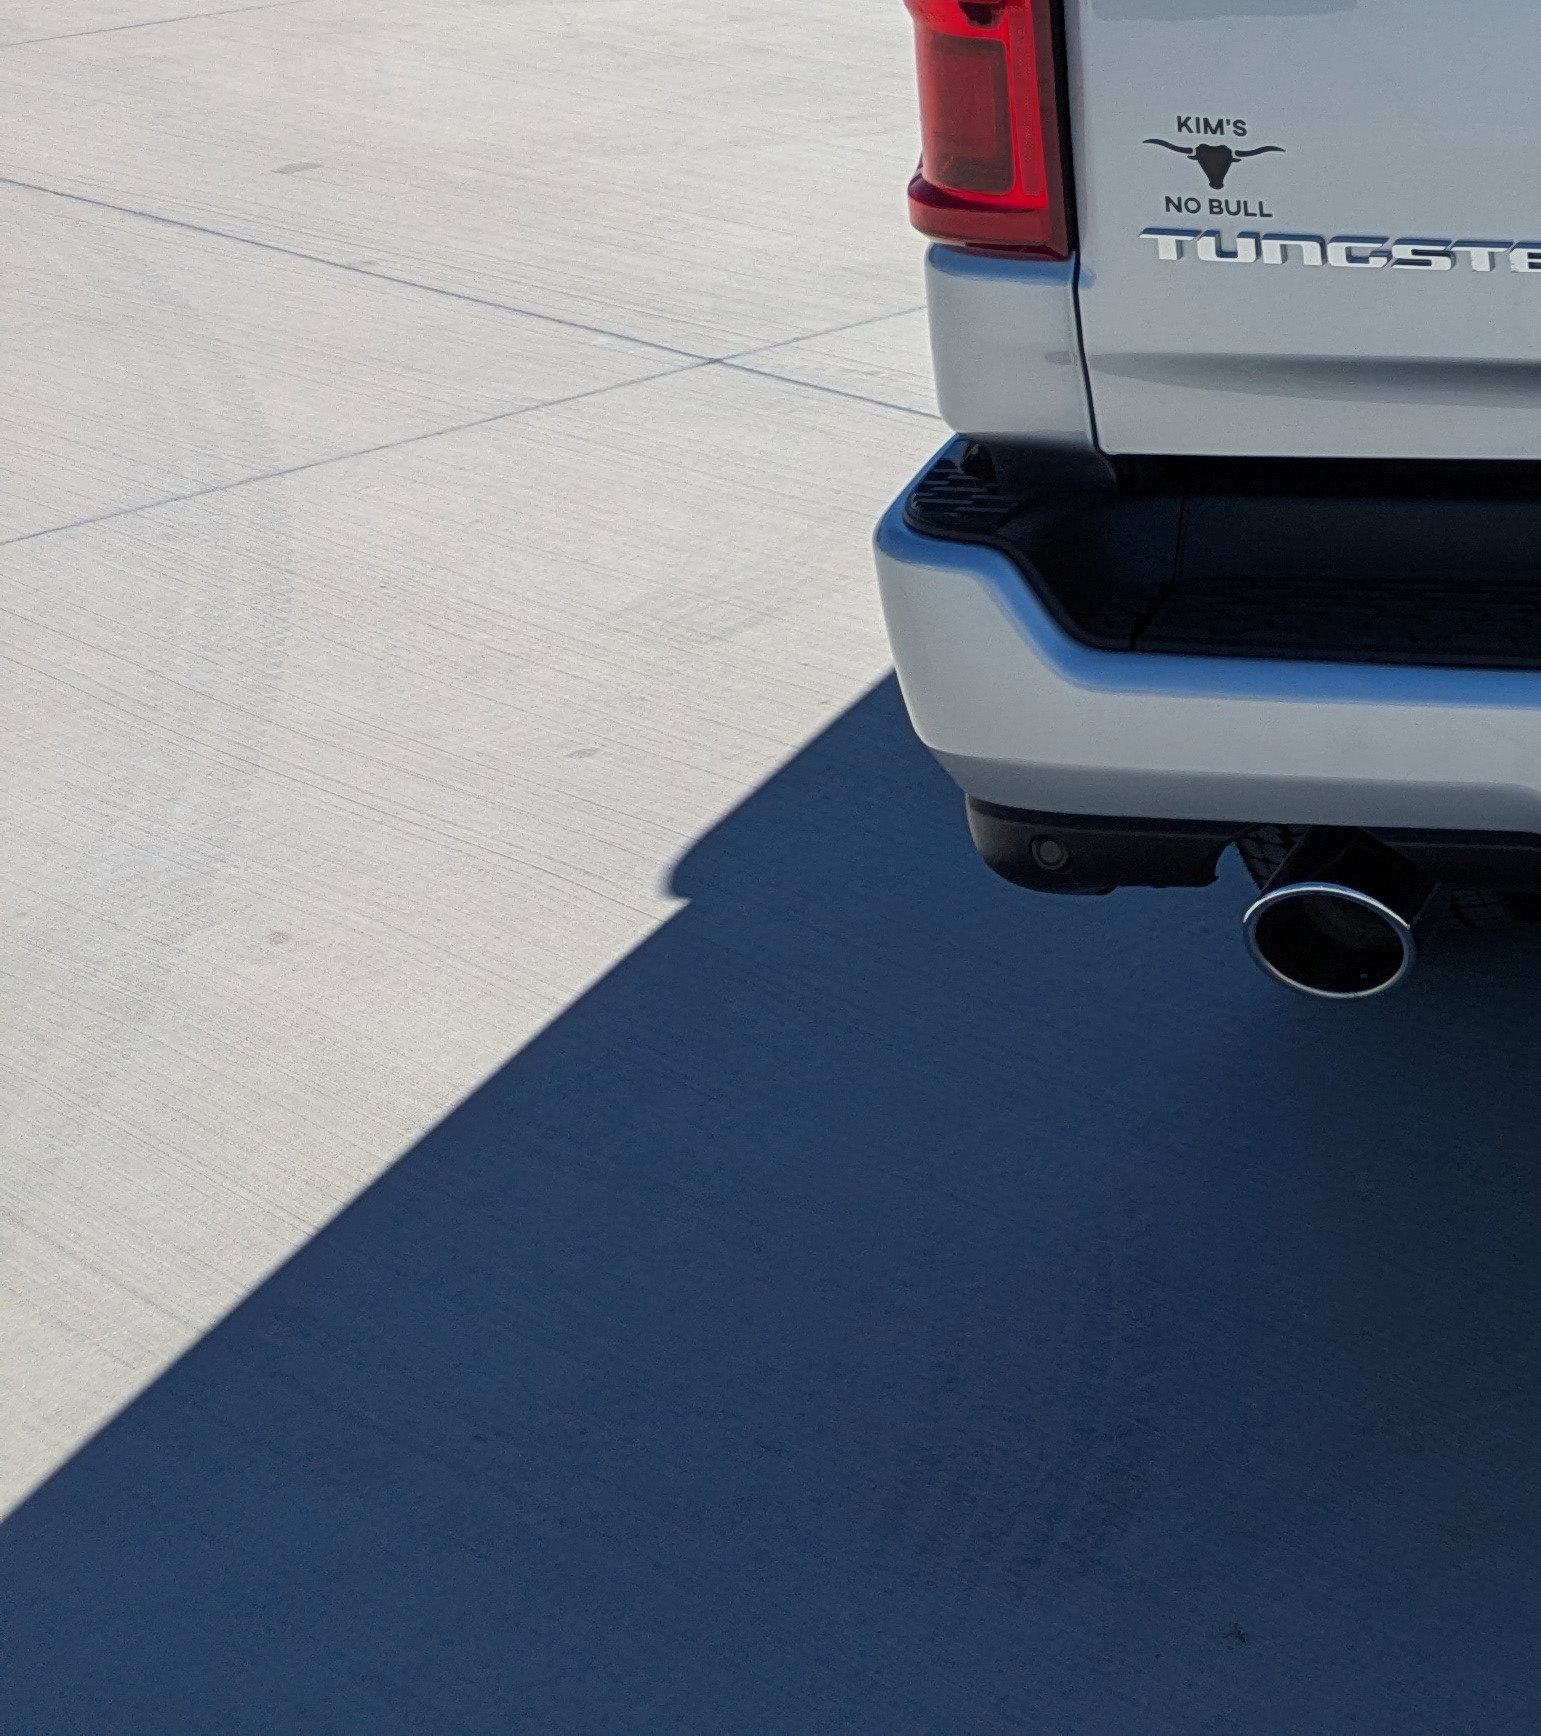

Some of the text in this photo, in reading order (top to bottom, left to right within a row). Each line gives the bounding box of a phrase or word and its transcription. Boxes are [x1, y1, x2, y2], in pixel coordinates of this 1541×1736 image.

[1176, 115, 1248, 137] KIM'S
[1164, 195, 1274, 218] NO BULL
